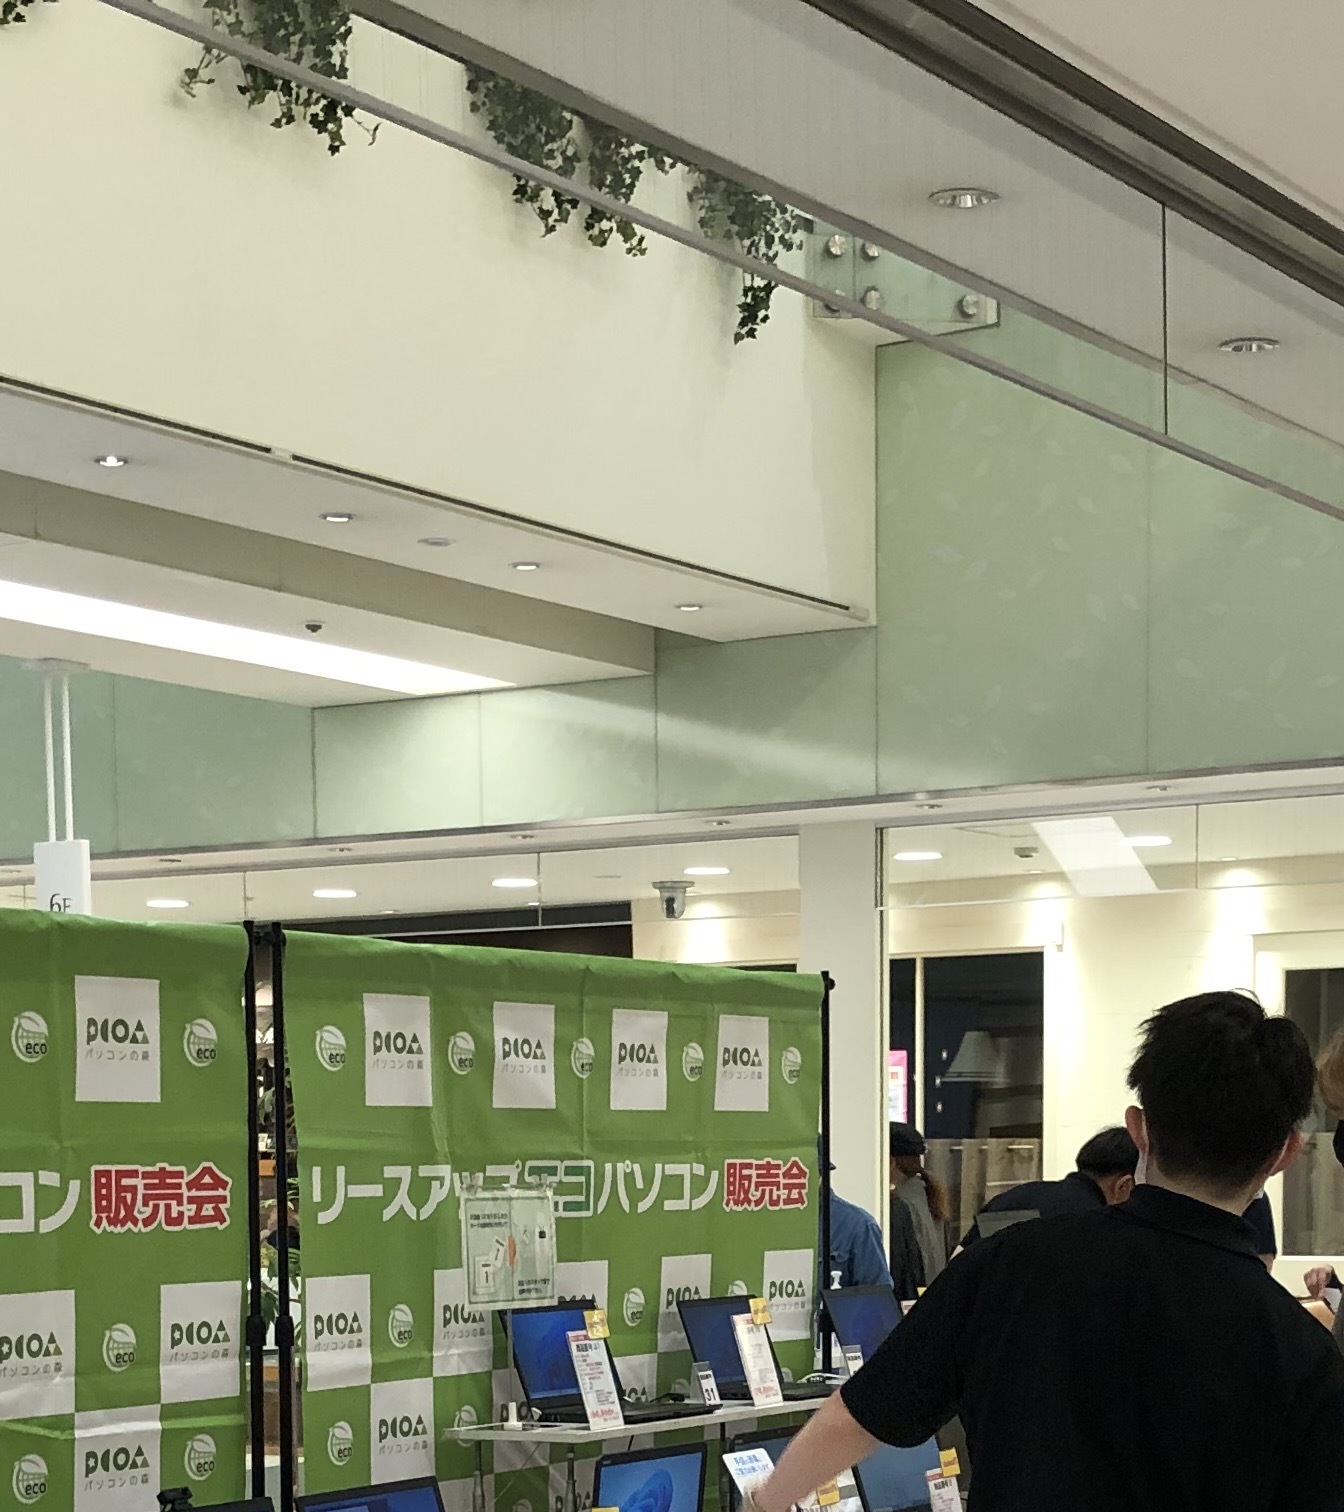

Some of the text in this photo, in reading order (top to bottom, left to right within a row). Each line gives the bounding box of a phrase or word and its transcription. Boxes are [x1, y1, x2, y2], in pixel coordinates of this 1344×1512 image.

[24, 1040, 48, 1055] eco
[85, 1047, 151, 1062] パソコンの森
[196, 1047, 217, 1061] eco
[327, 1053, 347, 1066] eco
[114, 1349, 135, 1364] eco
[705, 1387, 718, 1403] 31
[196, 1458, 215, 1473] eco
[25, 1480, 47, 1495] eco
[83, 1473, 151, 1492] パソコンの森
